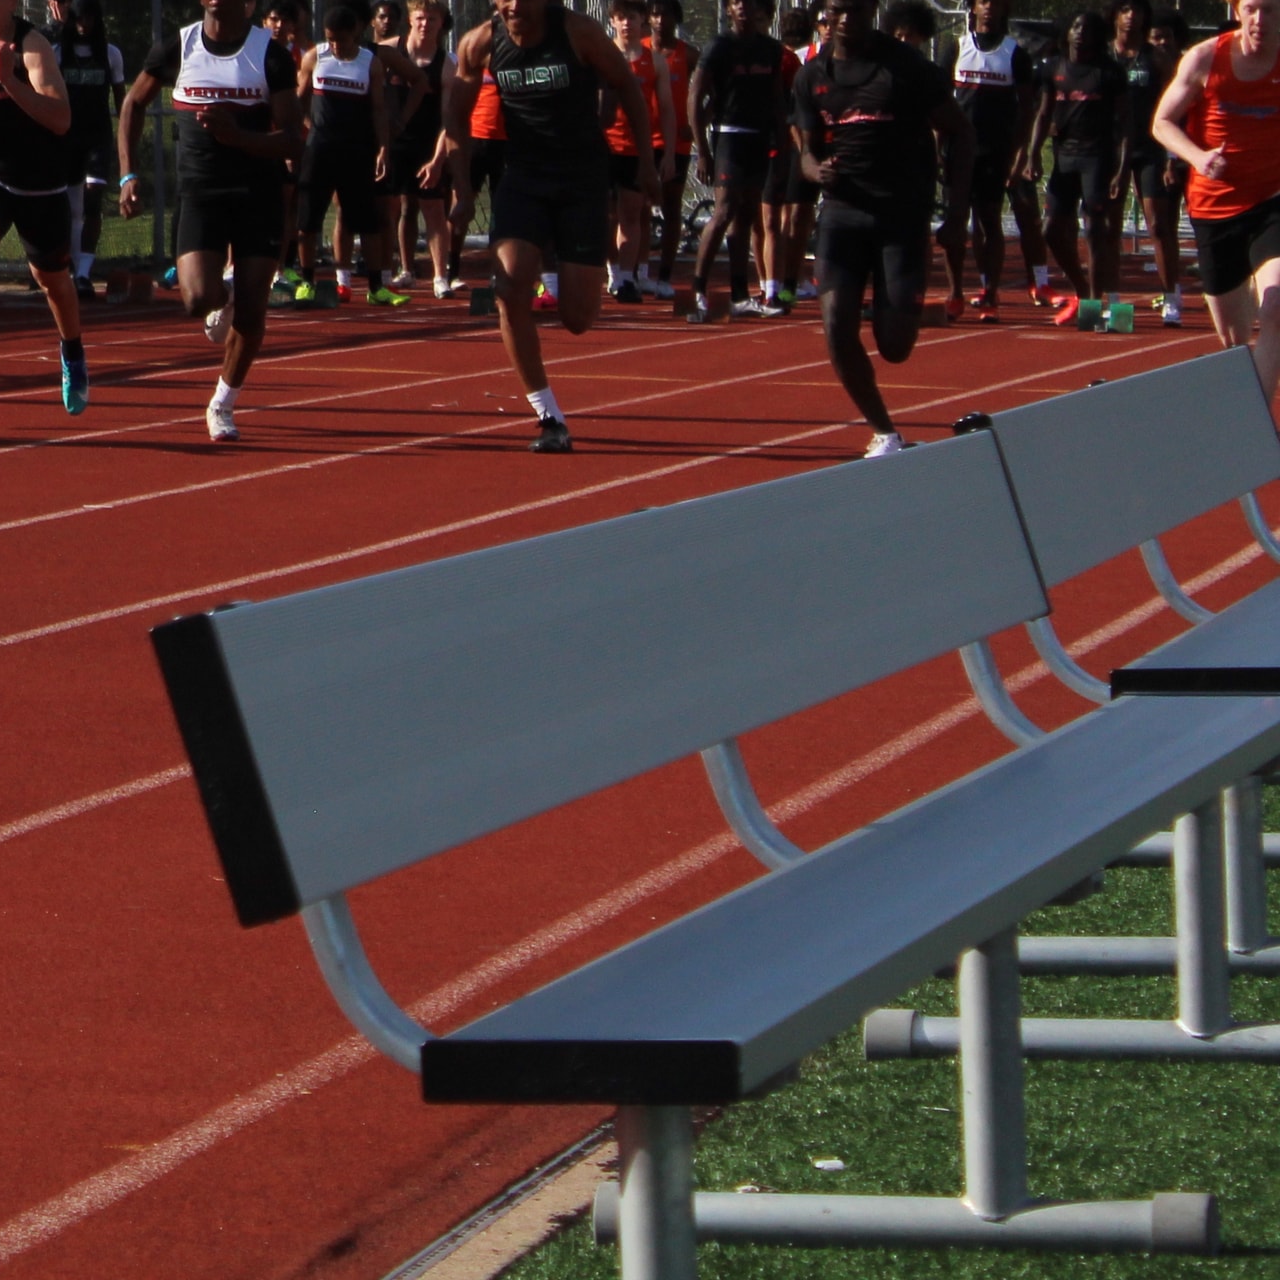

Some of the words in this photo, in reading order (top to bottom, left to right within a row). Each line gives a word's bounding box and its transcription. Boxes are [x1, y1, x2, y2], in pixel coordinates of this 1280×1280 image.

[497, 64, 570, 92] IRISH
[959, 70, 1008, 82] WHITEHALL
[316, 77, 366, 90] WHITEHALL
[183, 86, 263, 99] WHITEHALL
